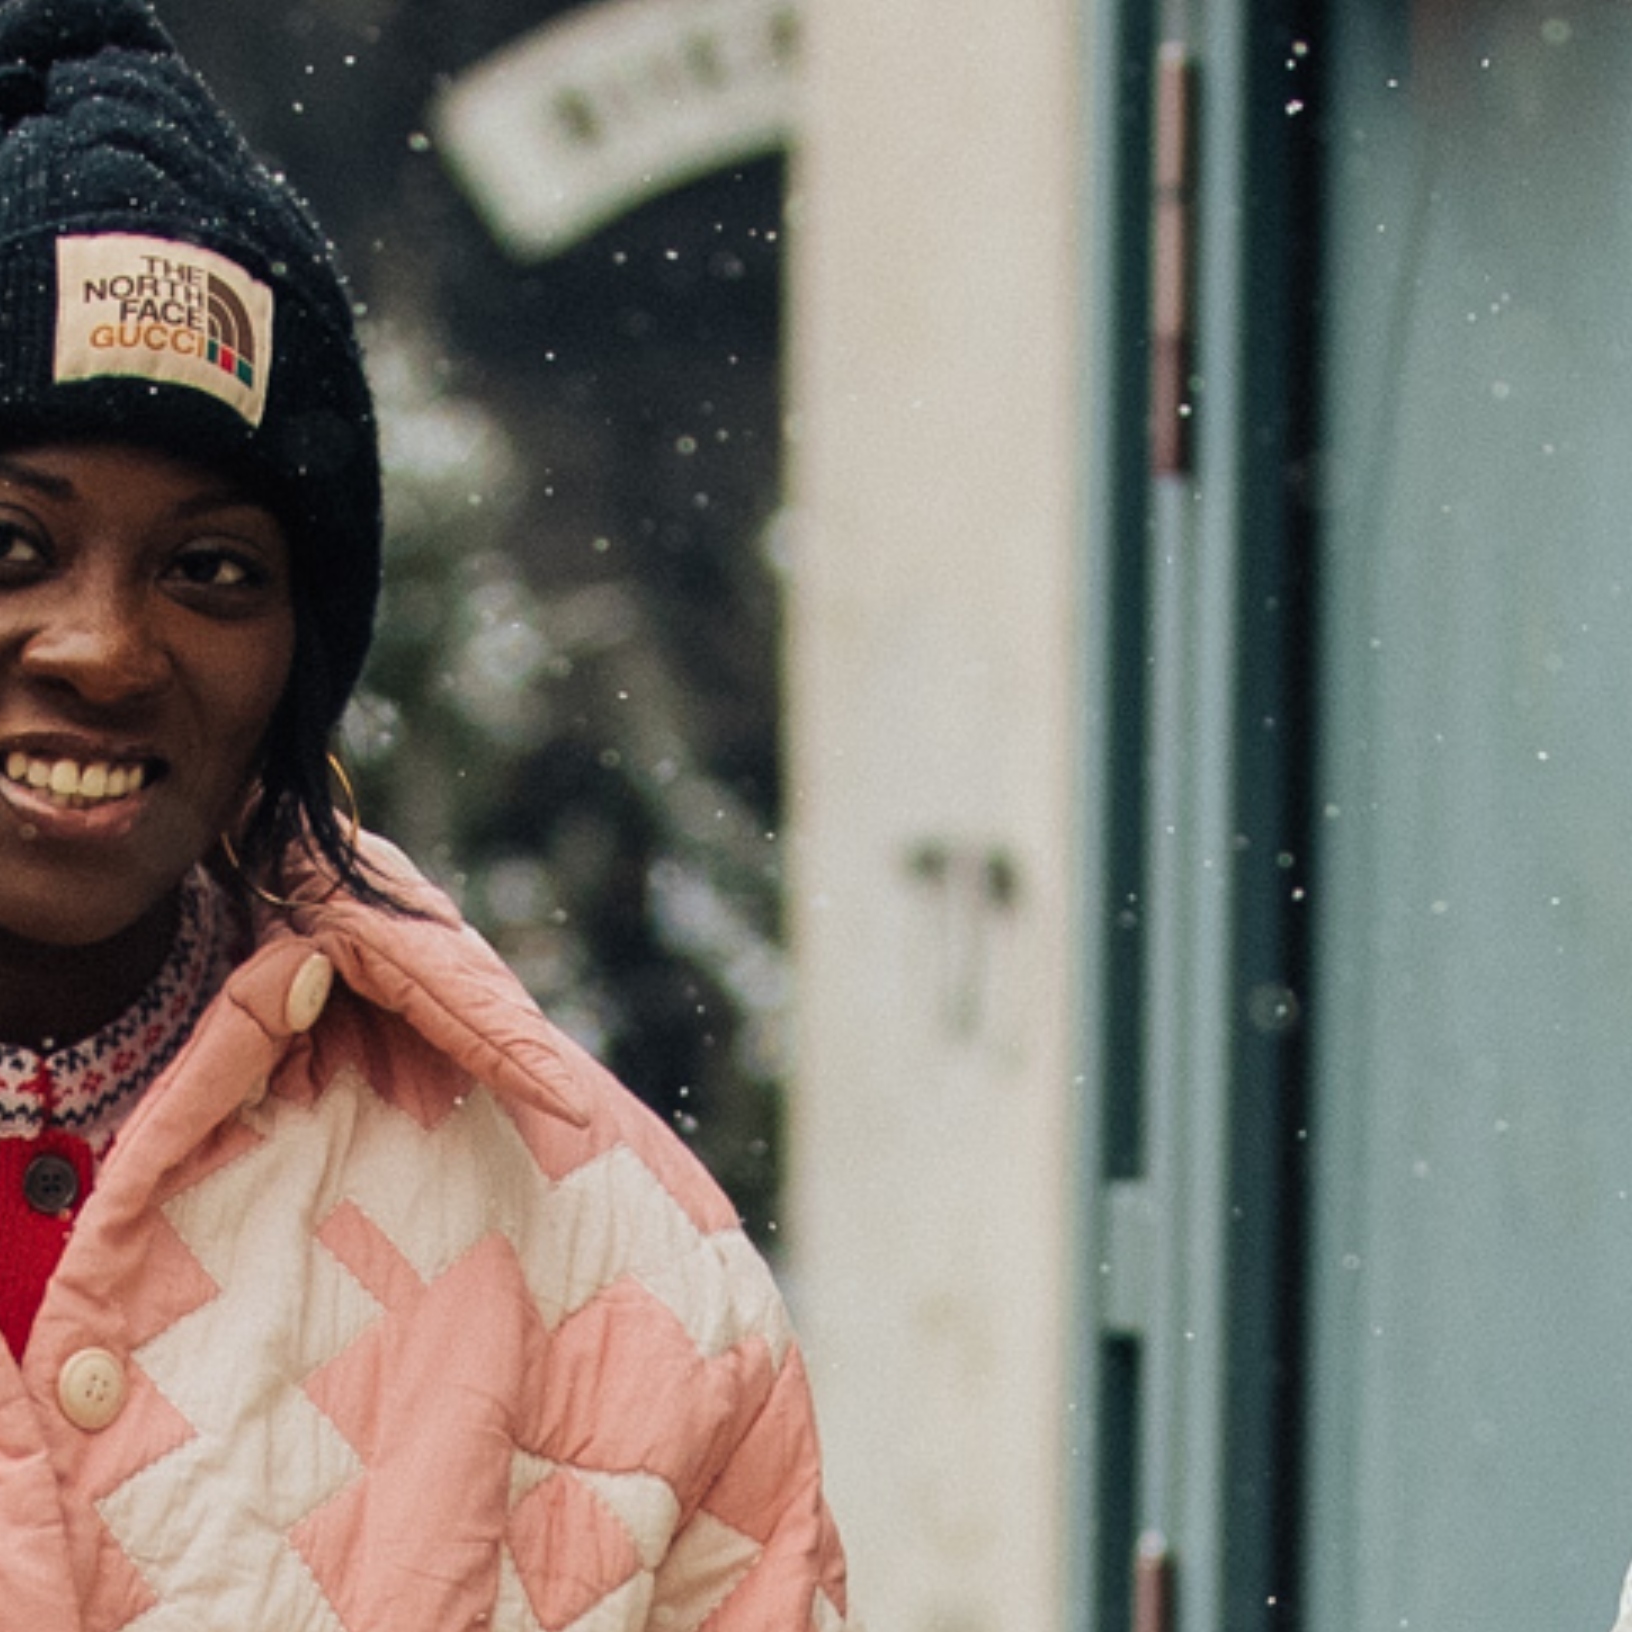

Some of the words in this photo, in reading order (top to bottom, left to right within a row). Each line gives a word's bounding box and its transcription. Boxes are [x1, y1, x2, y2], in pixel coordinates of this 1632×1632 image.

[140, 255, 204, 284] THE
[84, 275, 203, 307] NORTH
[120, 299, 204, 330] FACE
[90, 324, 205, 357] GUCCI
